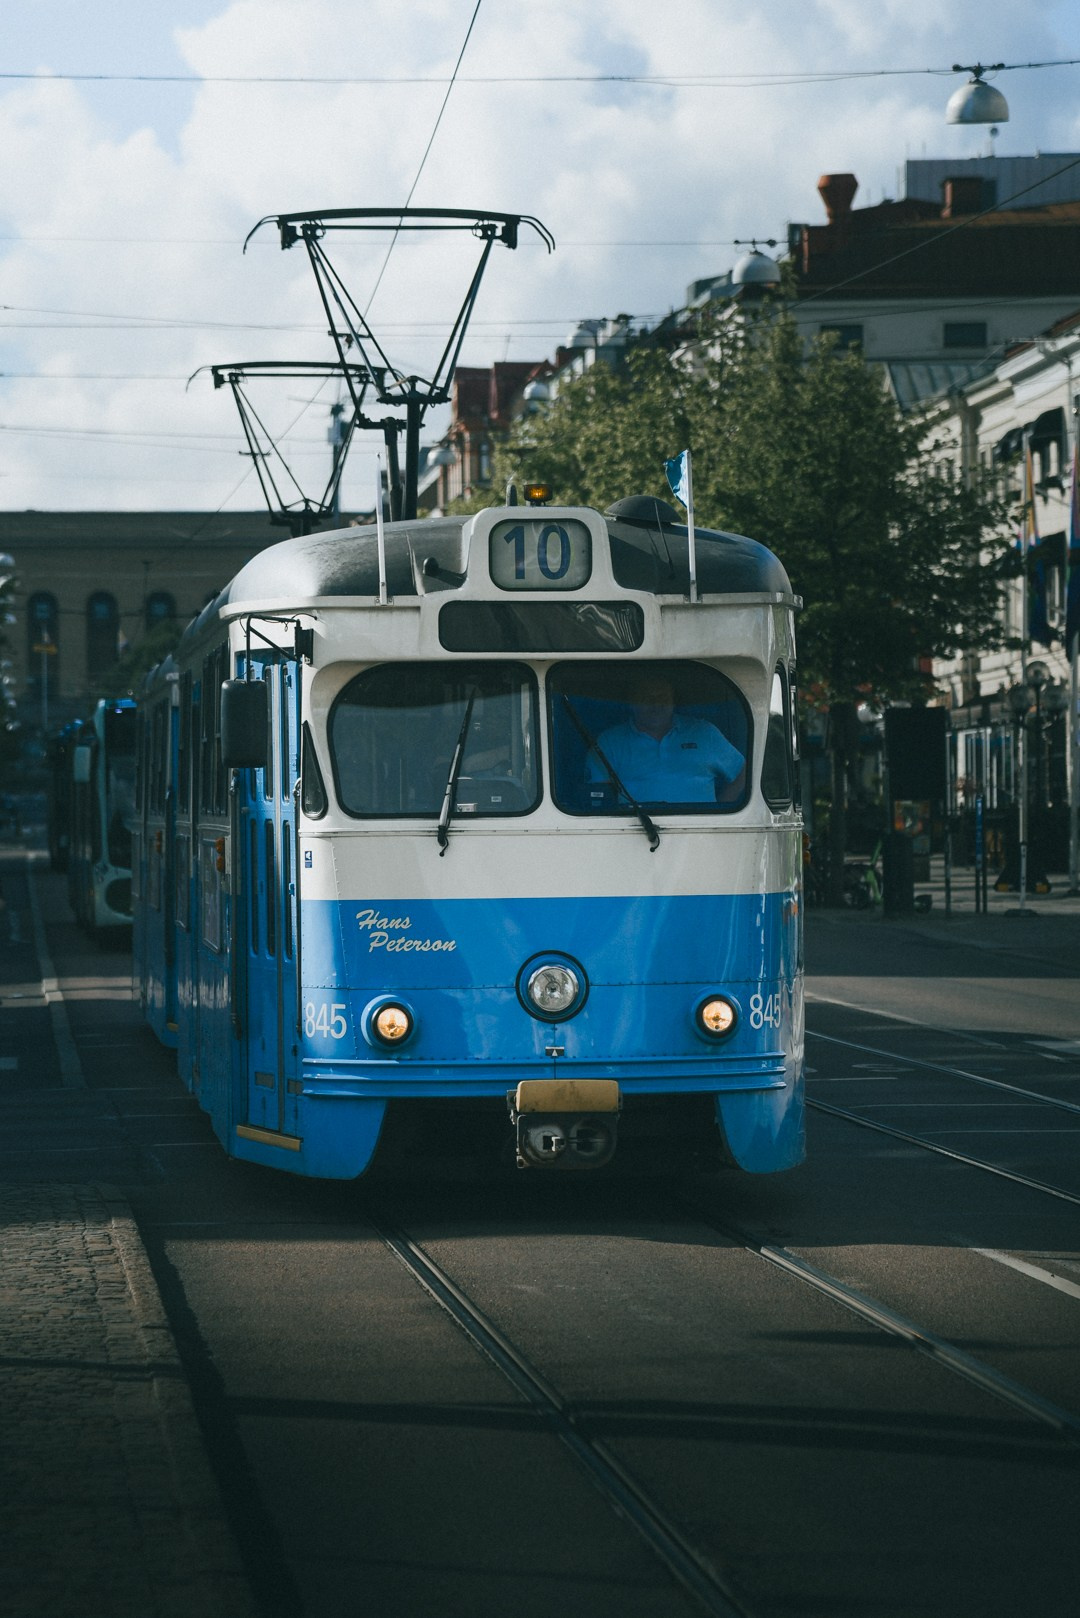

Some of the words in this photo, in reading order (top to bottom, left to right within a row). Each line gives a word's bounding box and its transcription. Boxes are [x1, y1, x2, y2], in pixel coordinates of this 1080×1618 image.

[503, 524, 571, 580] 10
[356, 909, 412, 930] Hans
[369, 931, 457, 953] Peterson
[305, 1002, 347, 1039] 845
[749, 994, 781, 1029] 845
